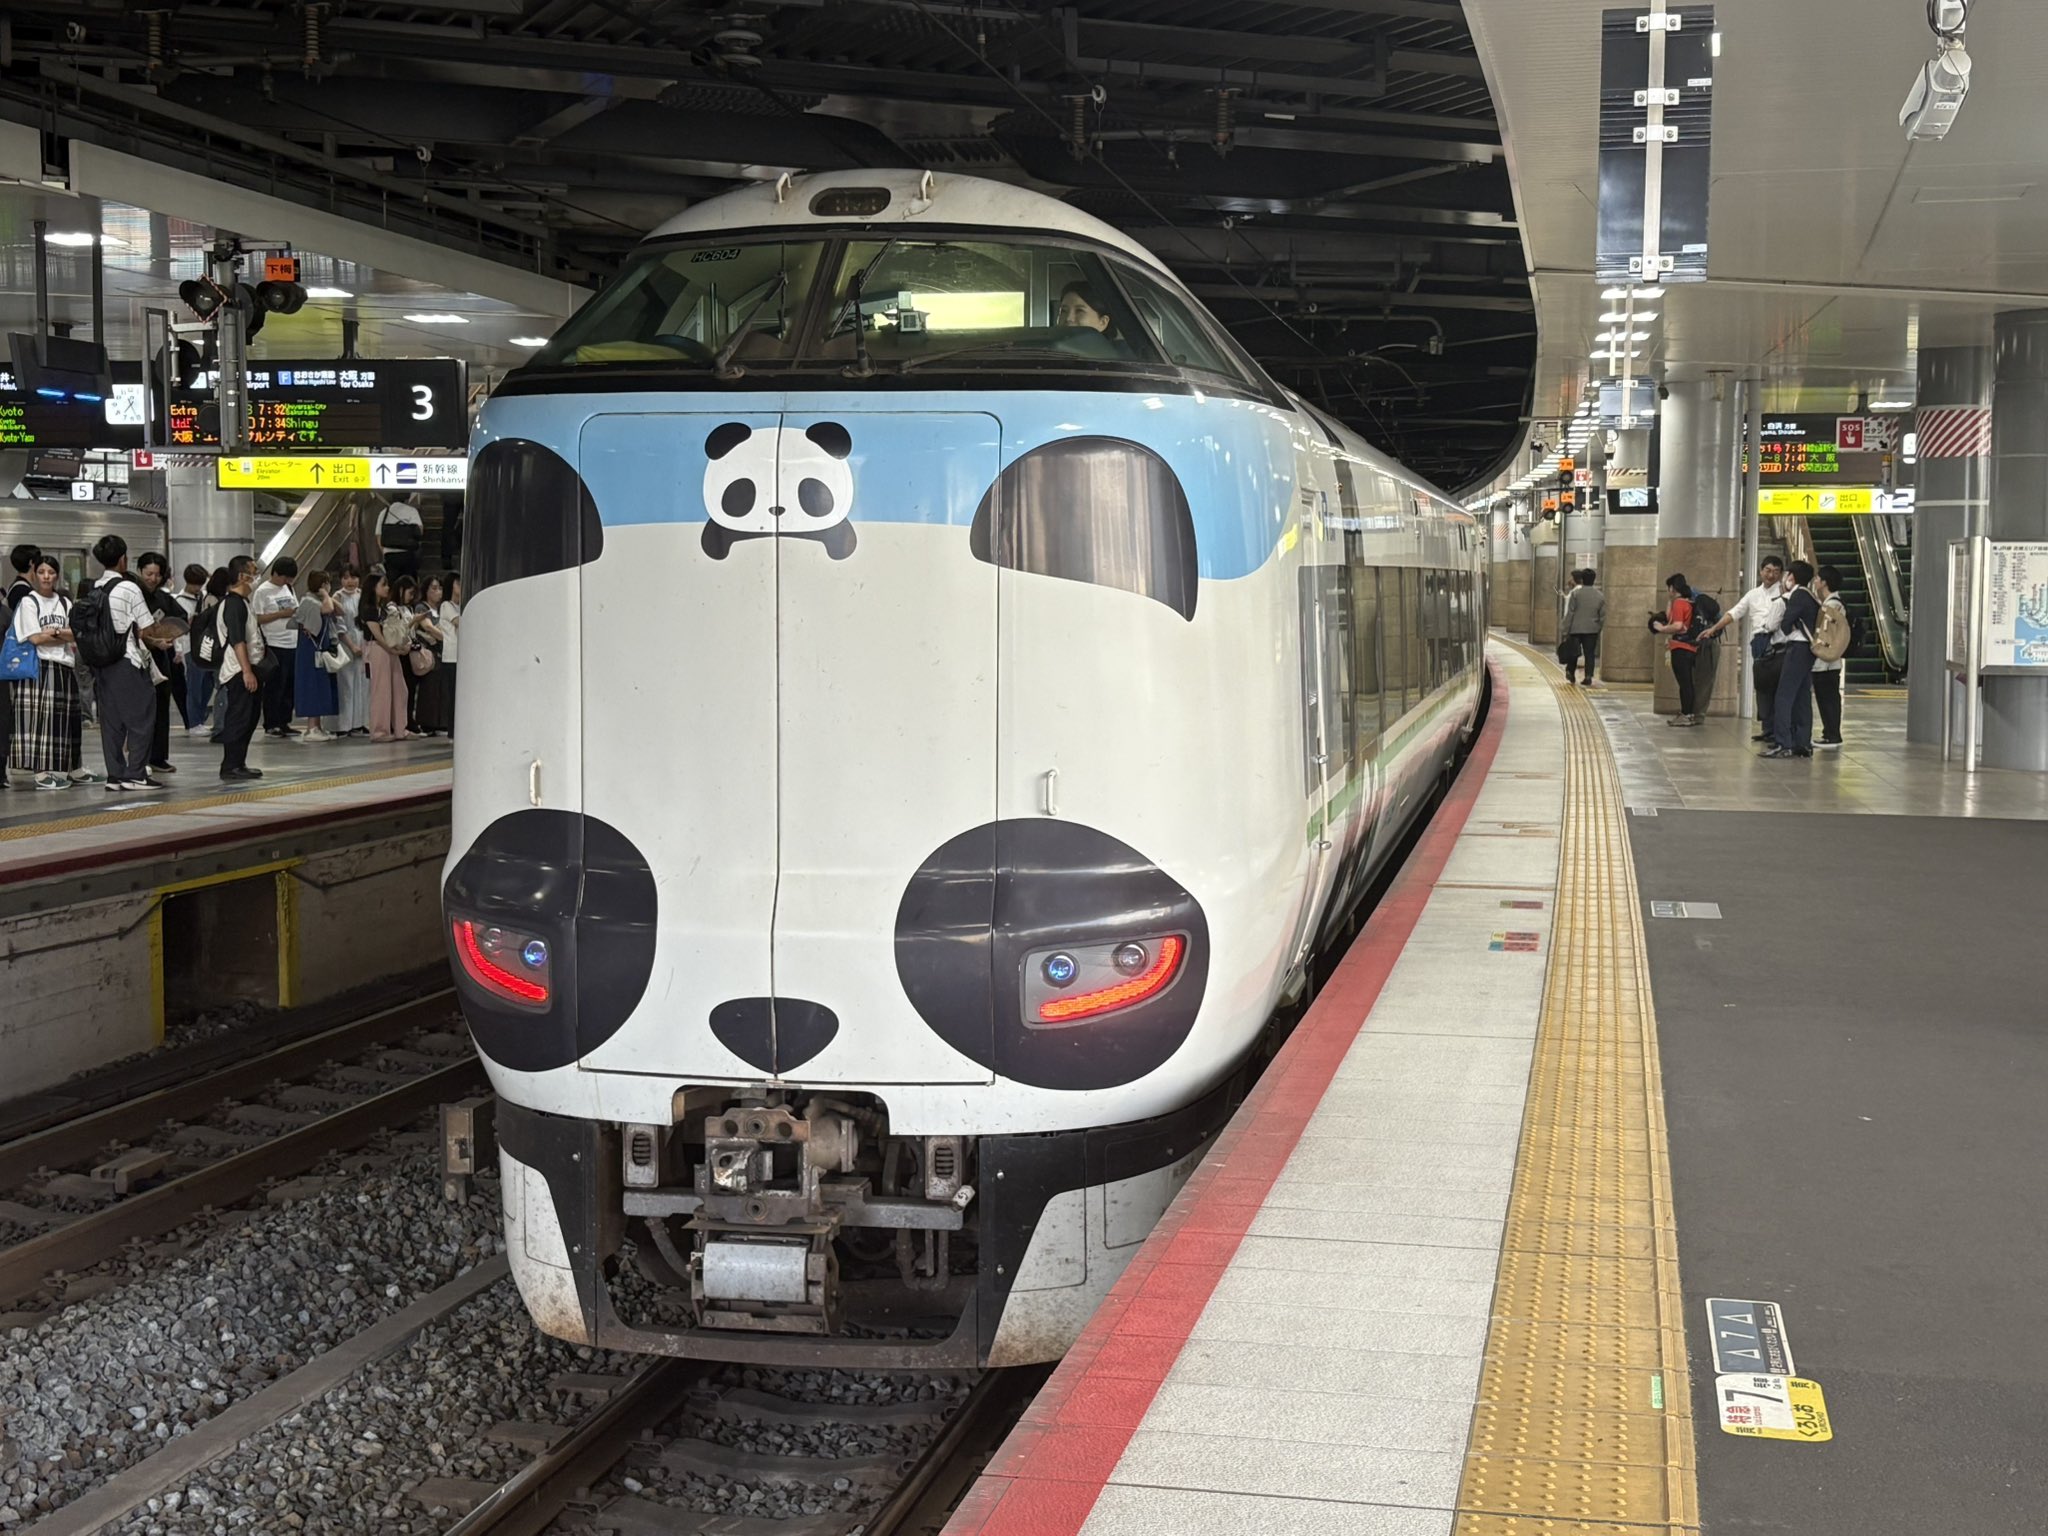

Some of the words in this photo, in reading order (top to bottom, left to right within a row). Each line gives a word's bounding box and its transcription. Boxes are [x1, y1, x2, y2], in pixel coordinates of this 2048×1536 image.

[339, 370, 358, 381] 大阪
[352, 380, 374, 388] Osaka
[411, 385, 434, 420] 3
[170, 404, 198, 416] Extra
[1842, 424, 1861, 432] SOS
[333, 463, 356, 474] 出口
[423, 464, 458, 474] 新幹線
[333, 475, 350, 483] Exit
[79, 485, 88, 498] 5
[1725, 1389, 1784, 1404] 7
[1726, 1405, 1751, 1424] 特急
[1793, 1403, 1819, 1437] くろしお
